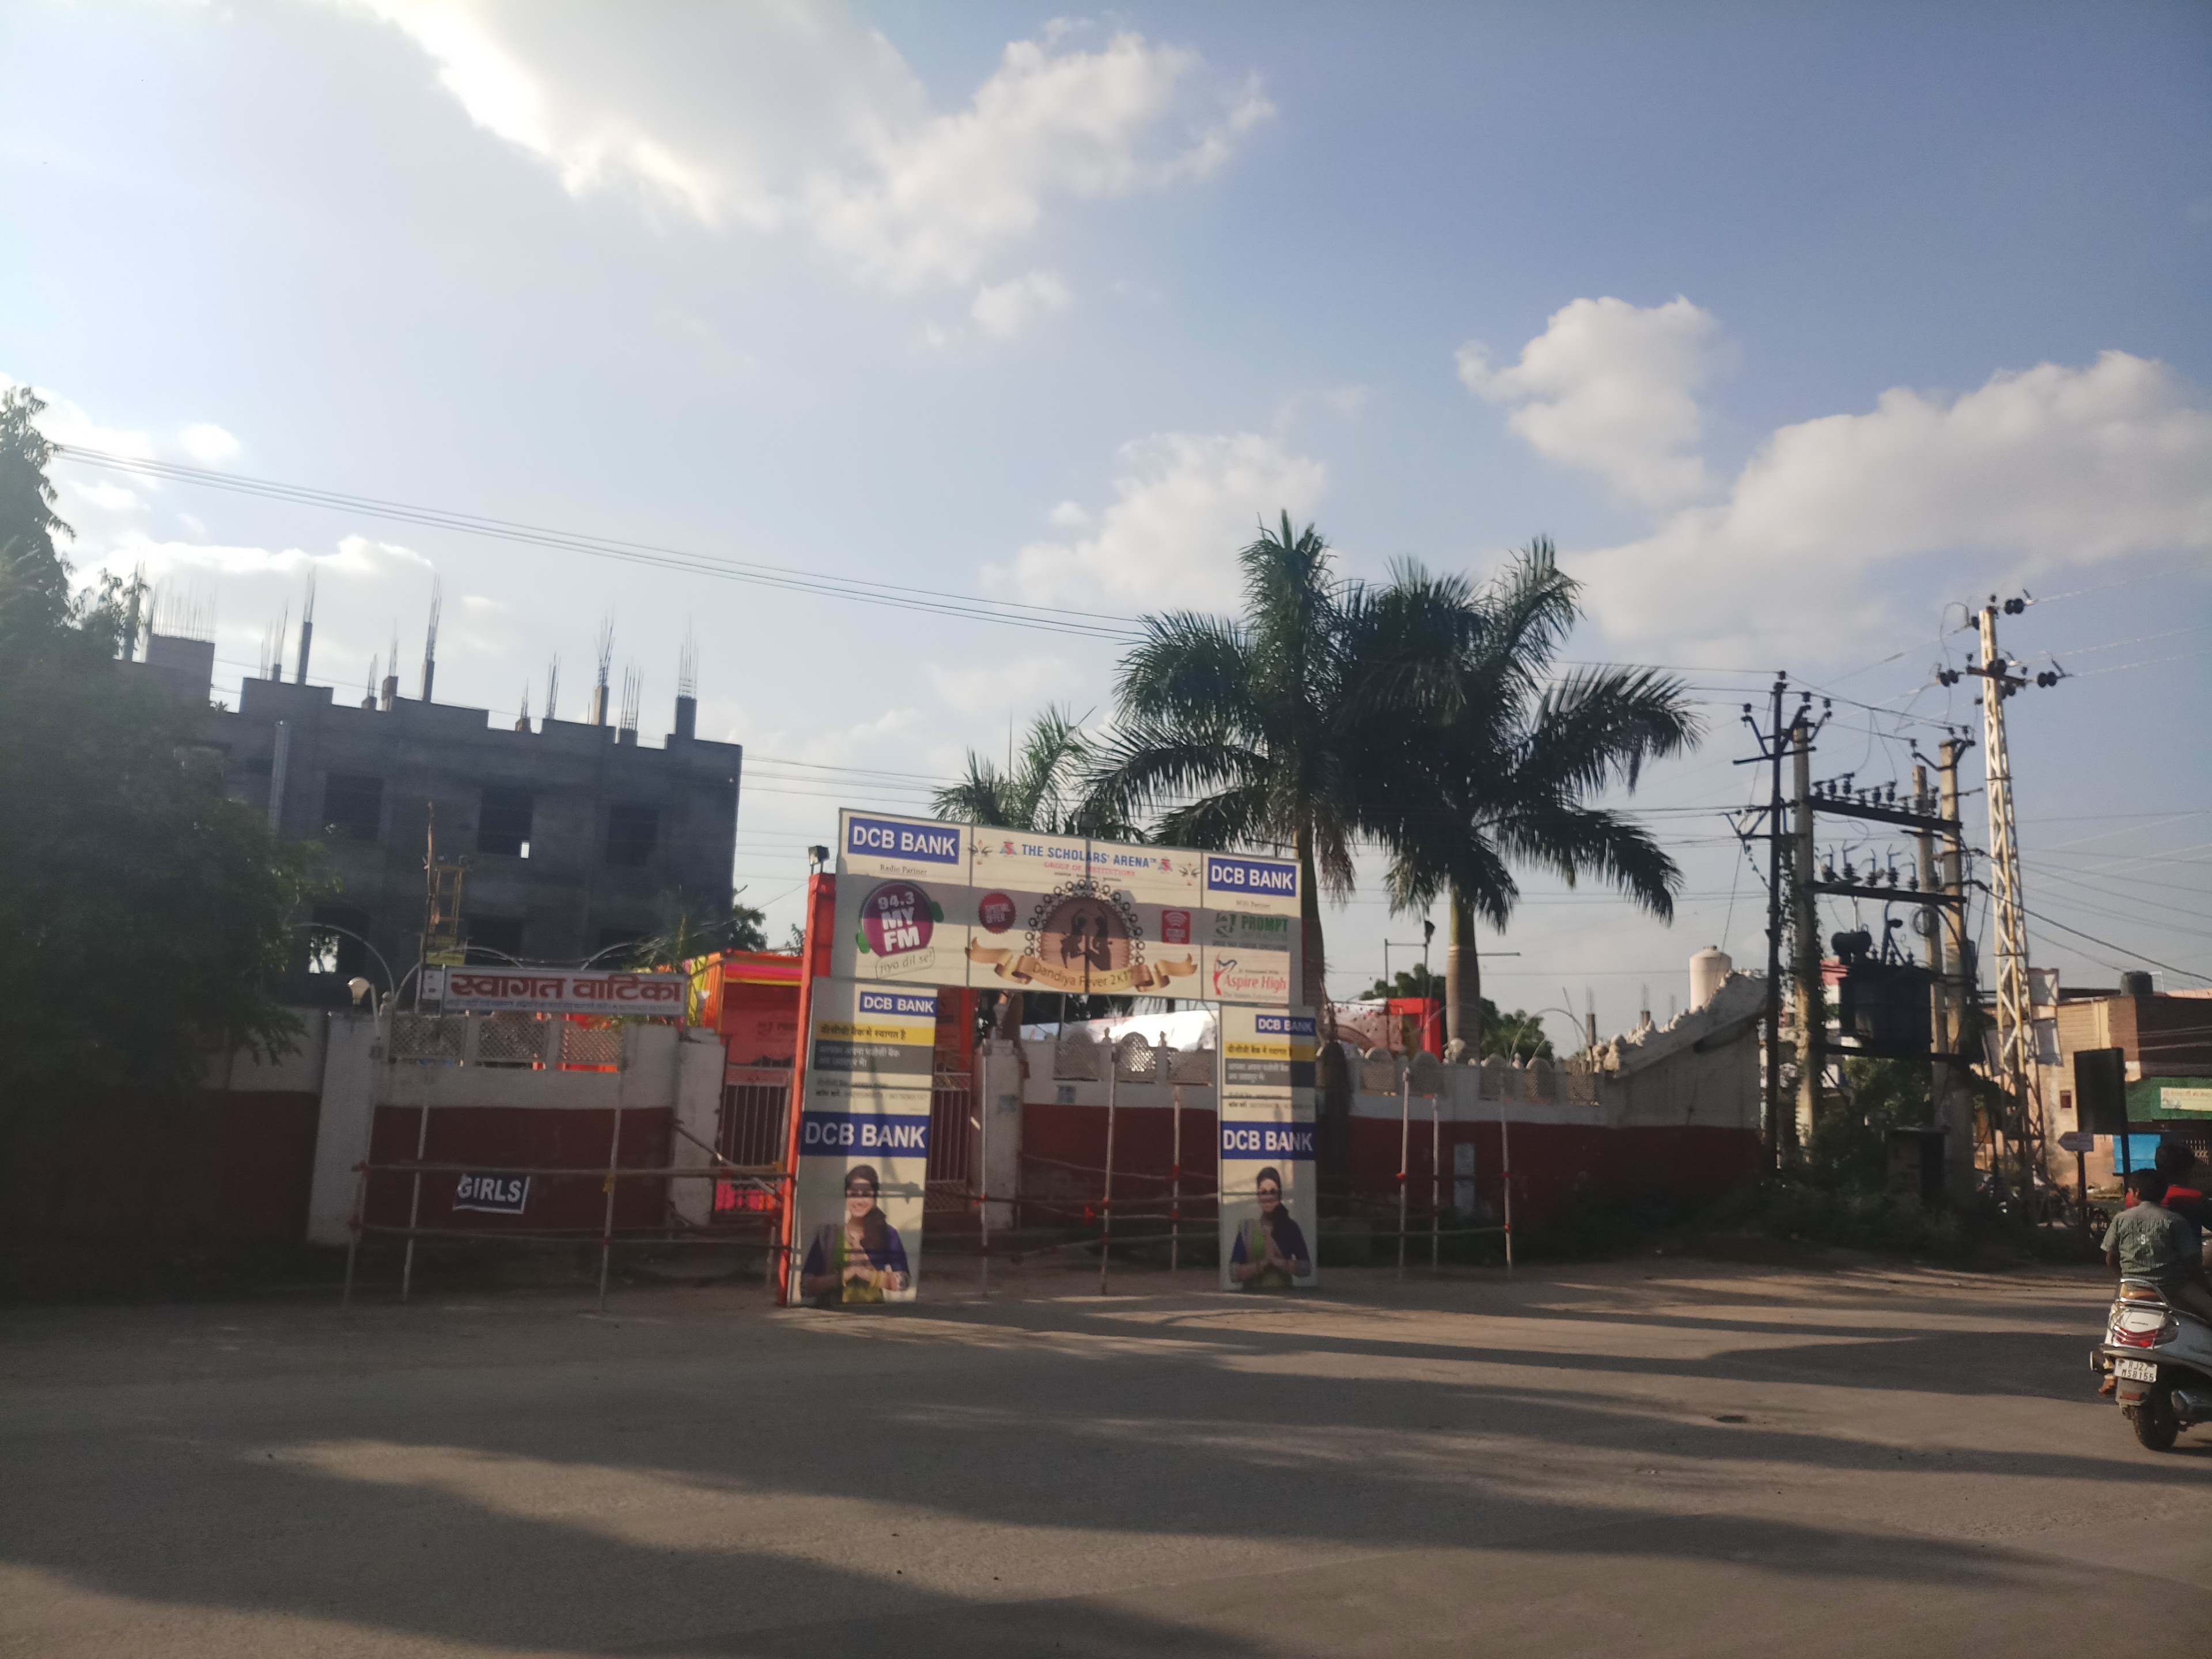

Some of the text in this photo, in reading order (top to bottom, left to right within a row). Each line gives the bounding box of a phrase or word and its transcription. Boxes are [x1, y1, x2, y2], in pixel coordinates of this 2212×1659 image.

[853, 825, 956, 857] DCB BANK
[1022, 844, 1044, 857] THE
[1047, 847, 1110, 863] SCHOLARS'
[880, 864, 927, 876] Radio Partner
[1211, 865, 1293, 890] DCB BANK
[878, 892, 915, 910] 94.3
[881, 907, 915, 930] MY
[883, 926, 921, 952] FM
[903, 956, 916, 969] dil
[450, 974, 683, 1002] स्वागत वाटिका
[1079, 975, 1108, 987] Fver
[864, 996, 934, 1013] DCB BANK
[1257, 1018, 1313, 1032] DCB BANK
[805, 1121, 926, 1149] DCB BANK
[1222, 1129, 1313, 1152] DCB BANK
[458, 1176, 522, 1203] GIRLS
